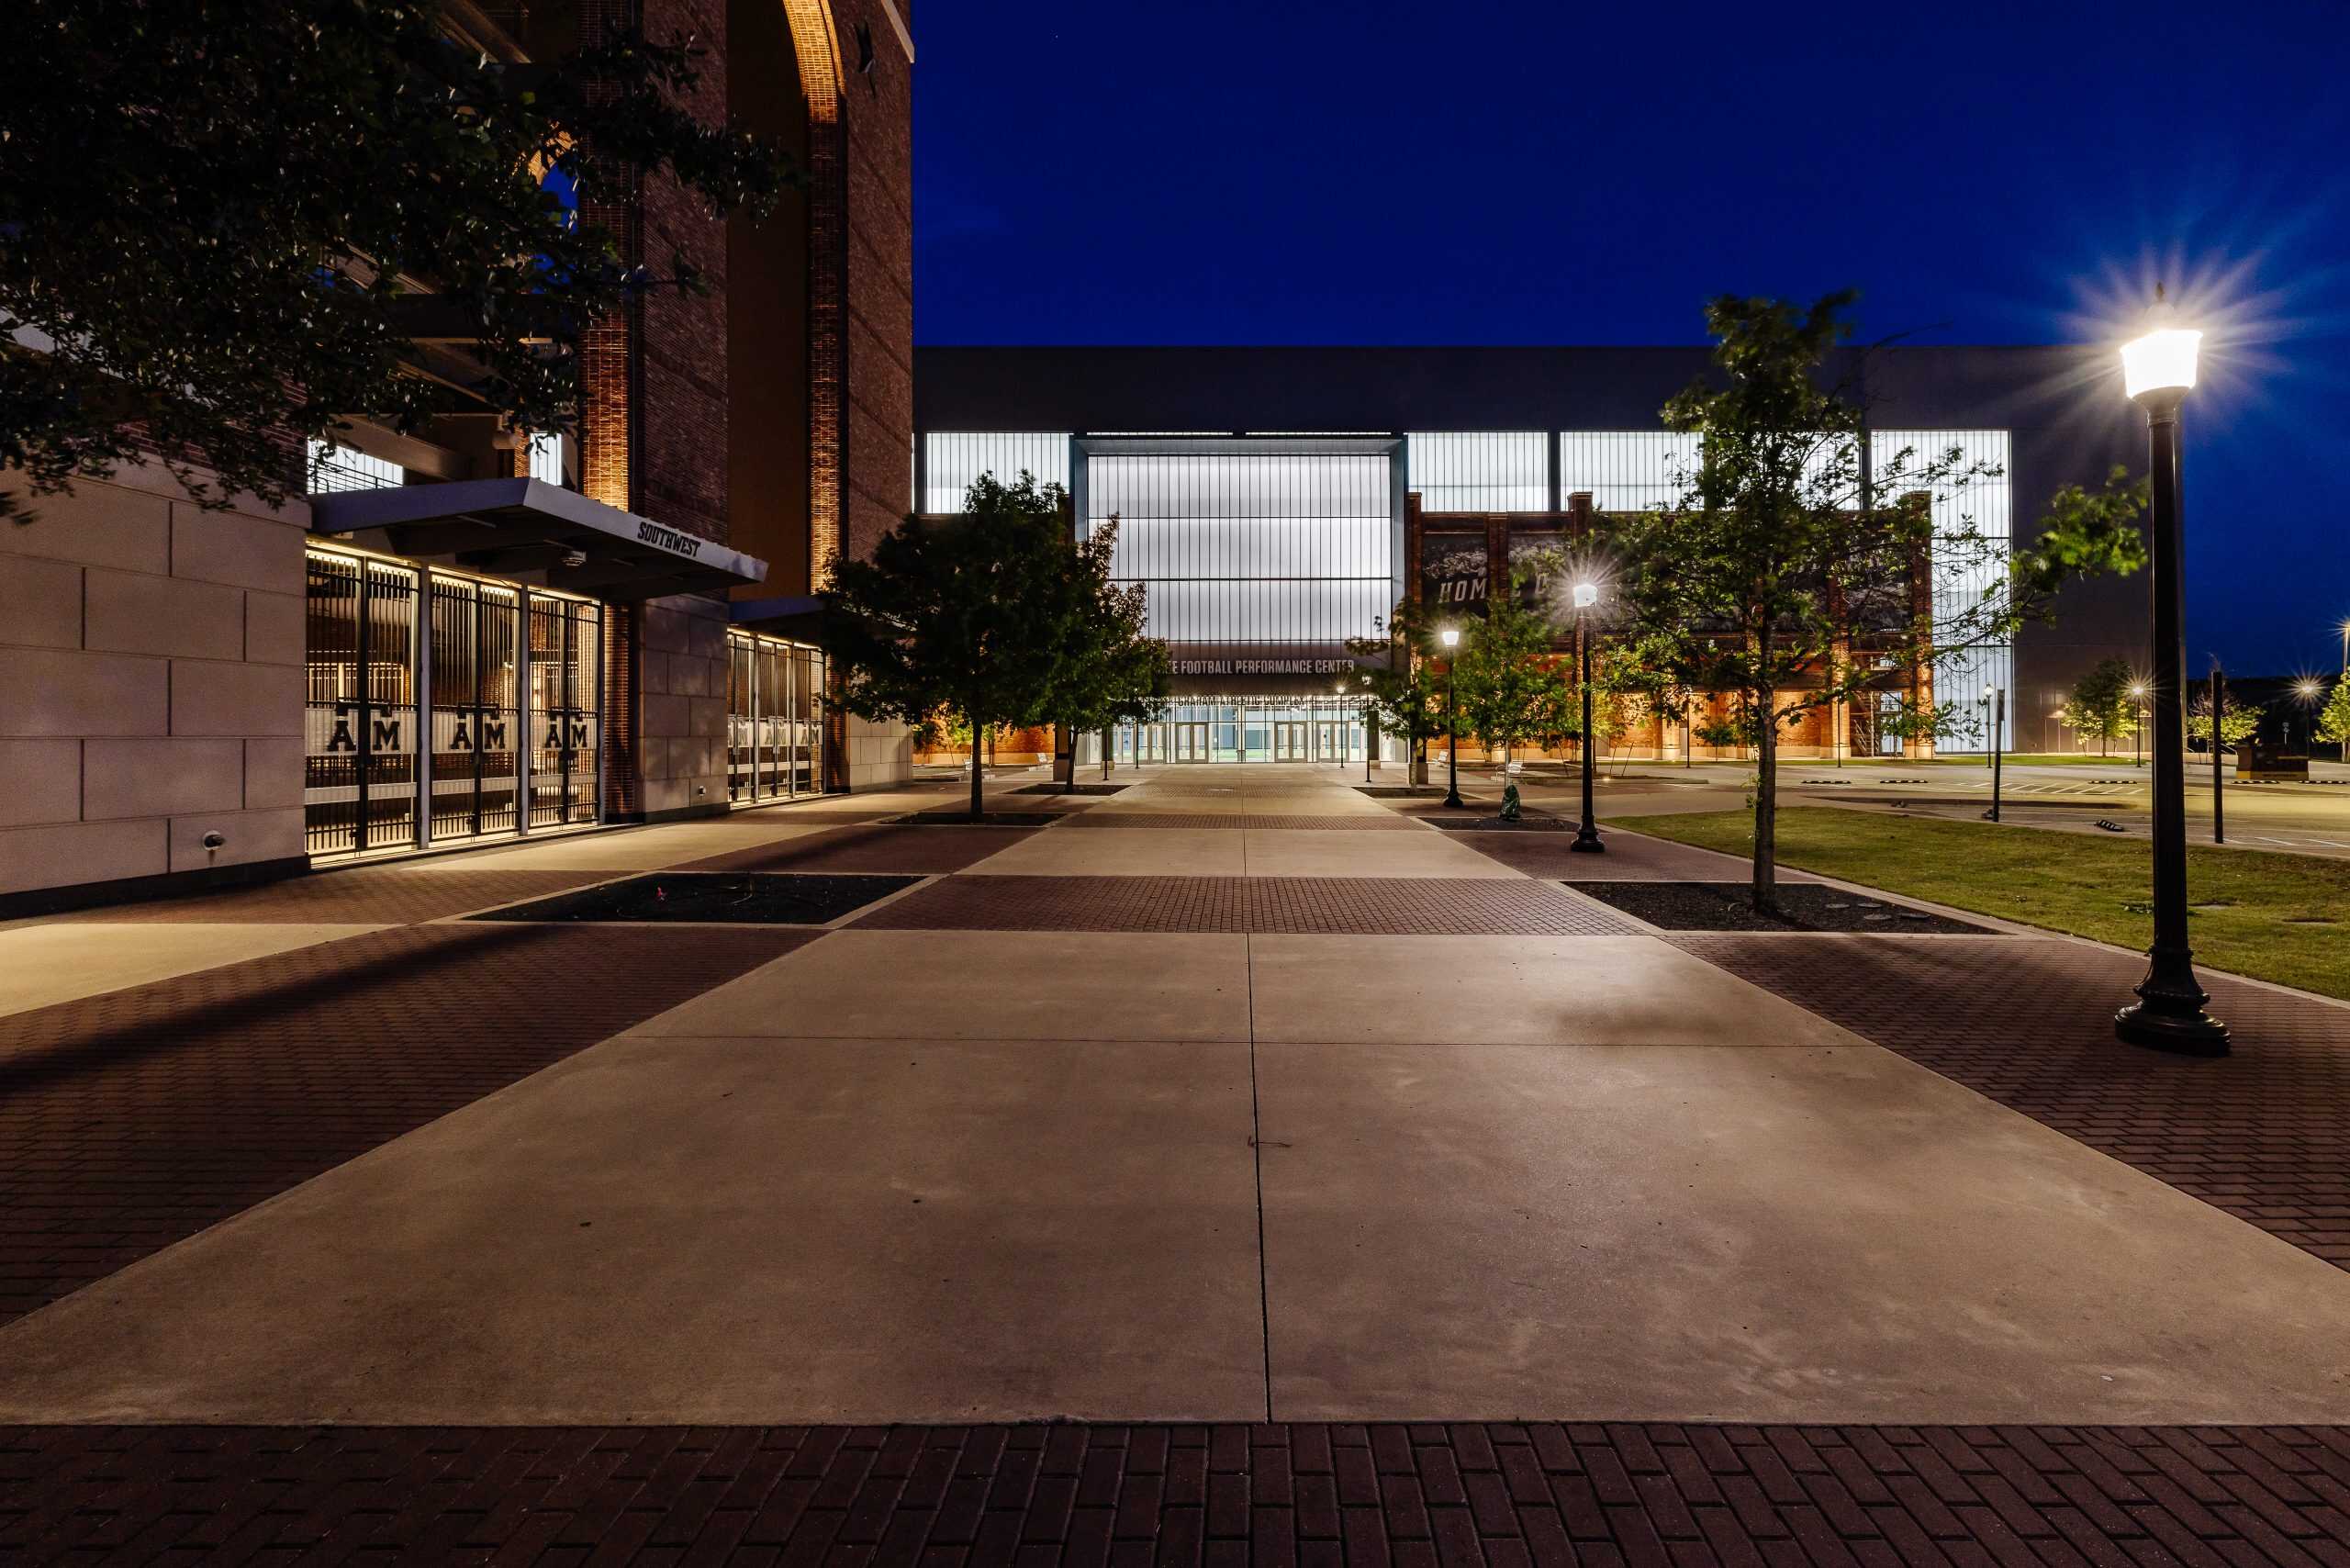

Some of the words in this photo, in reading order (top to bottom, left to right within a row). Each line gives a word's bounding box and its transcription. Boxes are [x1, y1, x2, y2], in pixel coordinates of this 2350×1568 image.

[637, 521, 700, 557] SOUTHWEST
[1181, 660, 1233, 674] FOOTBALL
[1236, 659, 1313, 674] PERFORMANCE
[1315, 659, 1355, 674] CENTER
